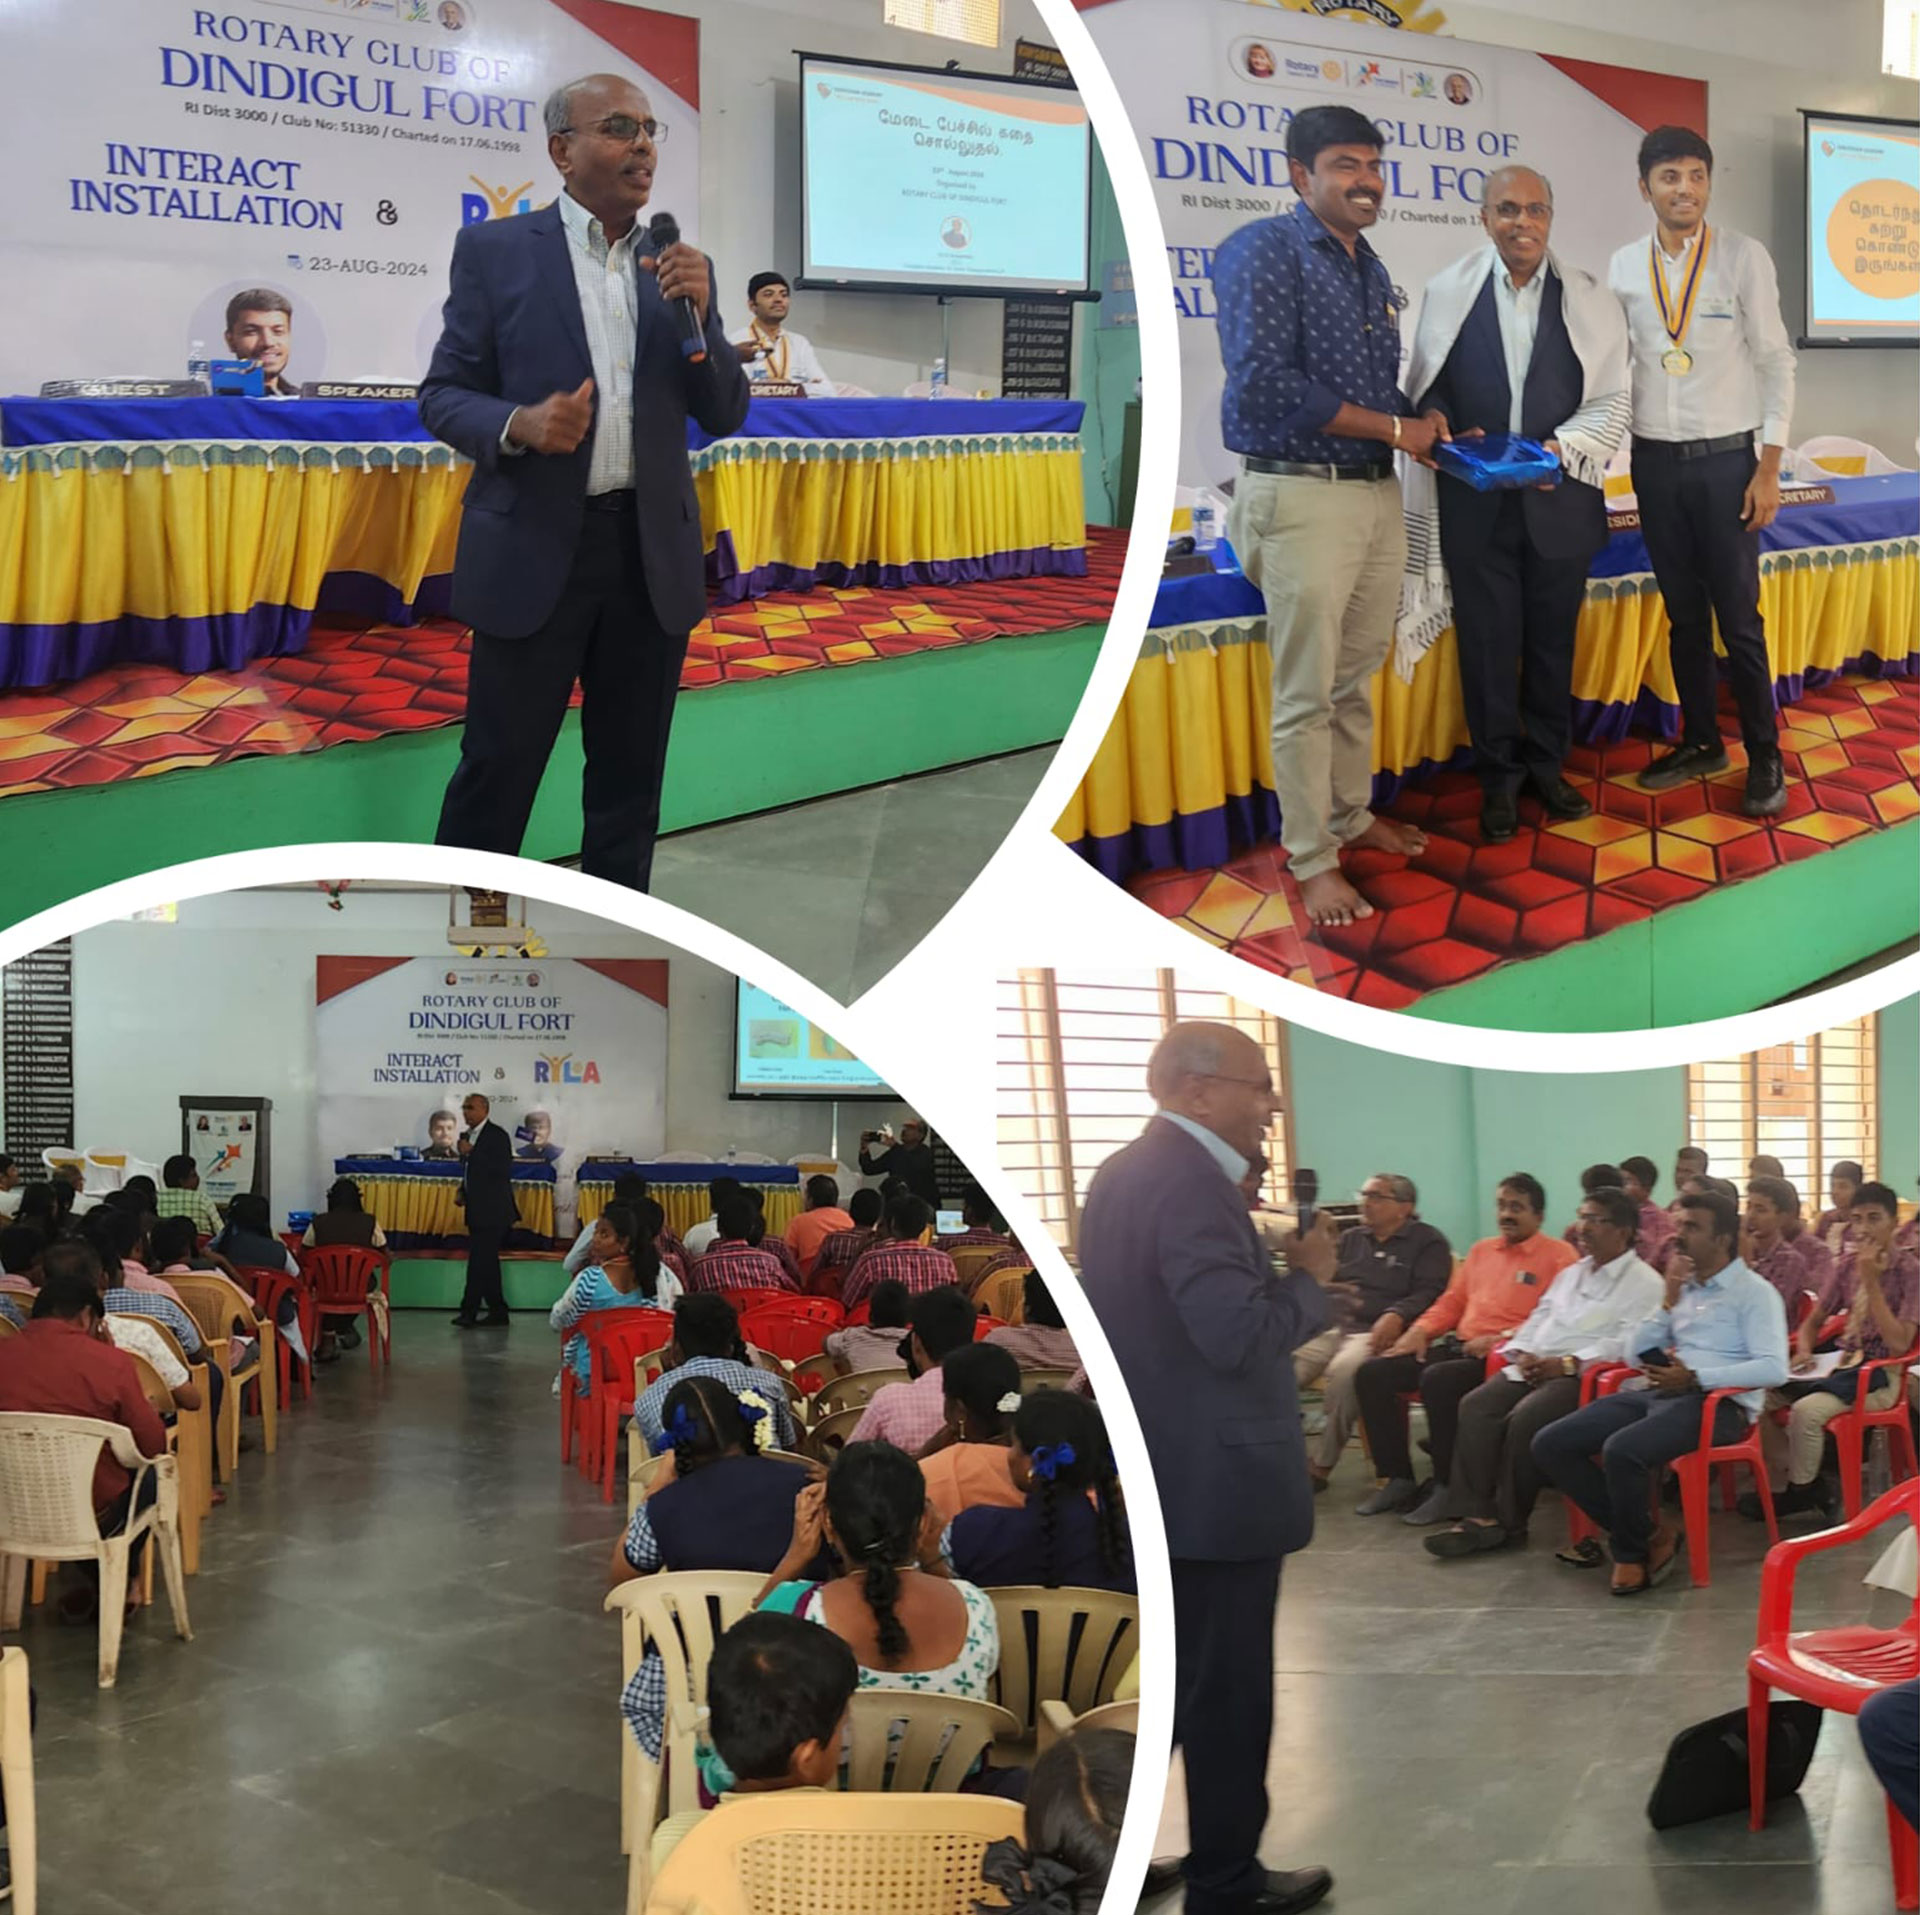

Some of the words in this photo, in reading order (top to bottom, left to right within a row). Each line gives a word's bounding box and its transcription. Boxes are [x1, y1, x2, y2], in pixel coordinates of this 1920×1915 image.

[193, 9, 354, 59] ROTARY
[366, 39, 457, 75] CLUB
[468, 56, 511, 82] OF
[159, 47, 410, 117] DINDIGUL
[421, 85, 535, 132] FORT
[184, 101, 199, 115] RI
[203, 104, 231, 118] Dist
[234, 108, 268, 123] 3000
[282, 114, 311, 129] Club
[315, 118, 338, 131] No:
[341, 121, 380, 137] 51330
[391, 128, 439, 145] Charted
[442, 135, 457, 146] on
[459, 135, 522, 153] 17.06.1998
[1186, 95, 1296, 134] ROTA
[1477, 130, 1519, 157] OF
[104, 142, 302, 191] INTERACT
[1151, 136, 1419, 200] DINDL
[1430, 164, 1495, 204] FO
[68, 179, 344, 231] INSTALLATION
[375, 199, 399, 226] &
[1181, 194, 1198, 208] RI
[1201, 195, 1231, 211] Dist
[1234, 198, 1271, 212] 3000
[1400, 210, 1448, 224] Charted
[1453, 215, 1467, 225] on
[309, 256, 429, 277] 23-AUG-2024
[80, 383, 170, 396] GUEST
[317, 384, 416, 398] SPEAKER
[1779, 488, 1827, 505] CRETARY
[422, 995, 489, 1008] ROTARY
[493, 996, 536, 1008] CLUB
[540, 997, 562, 1008] OF
[409, 1012, 512, 1030] DINDIGUL
[518, 1013, 575, 1031] FORT
[373, 1068, 480, 1084] INSTALLATION
[494, 1067, 505, 1080] &
[534, 1052, 600, 1084] RYLA
[387, 1053, 463, 1068] INTERACT
